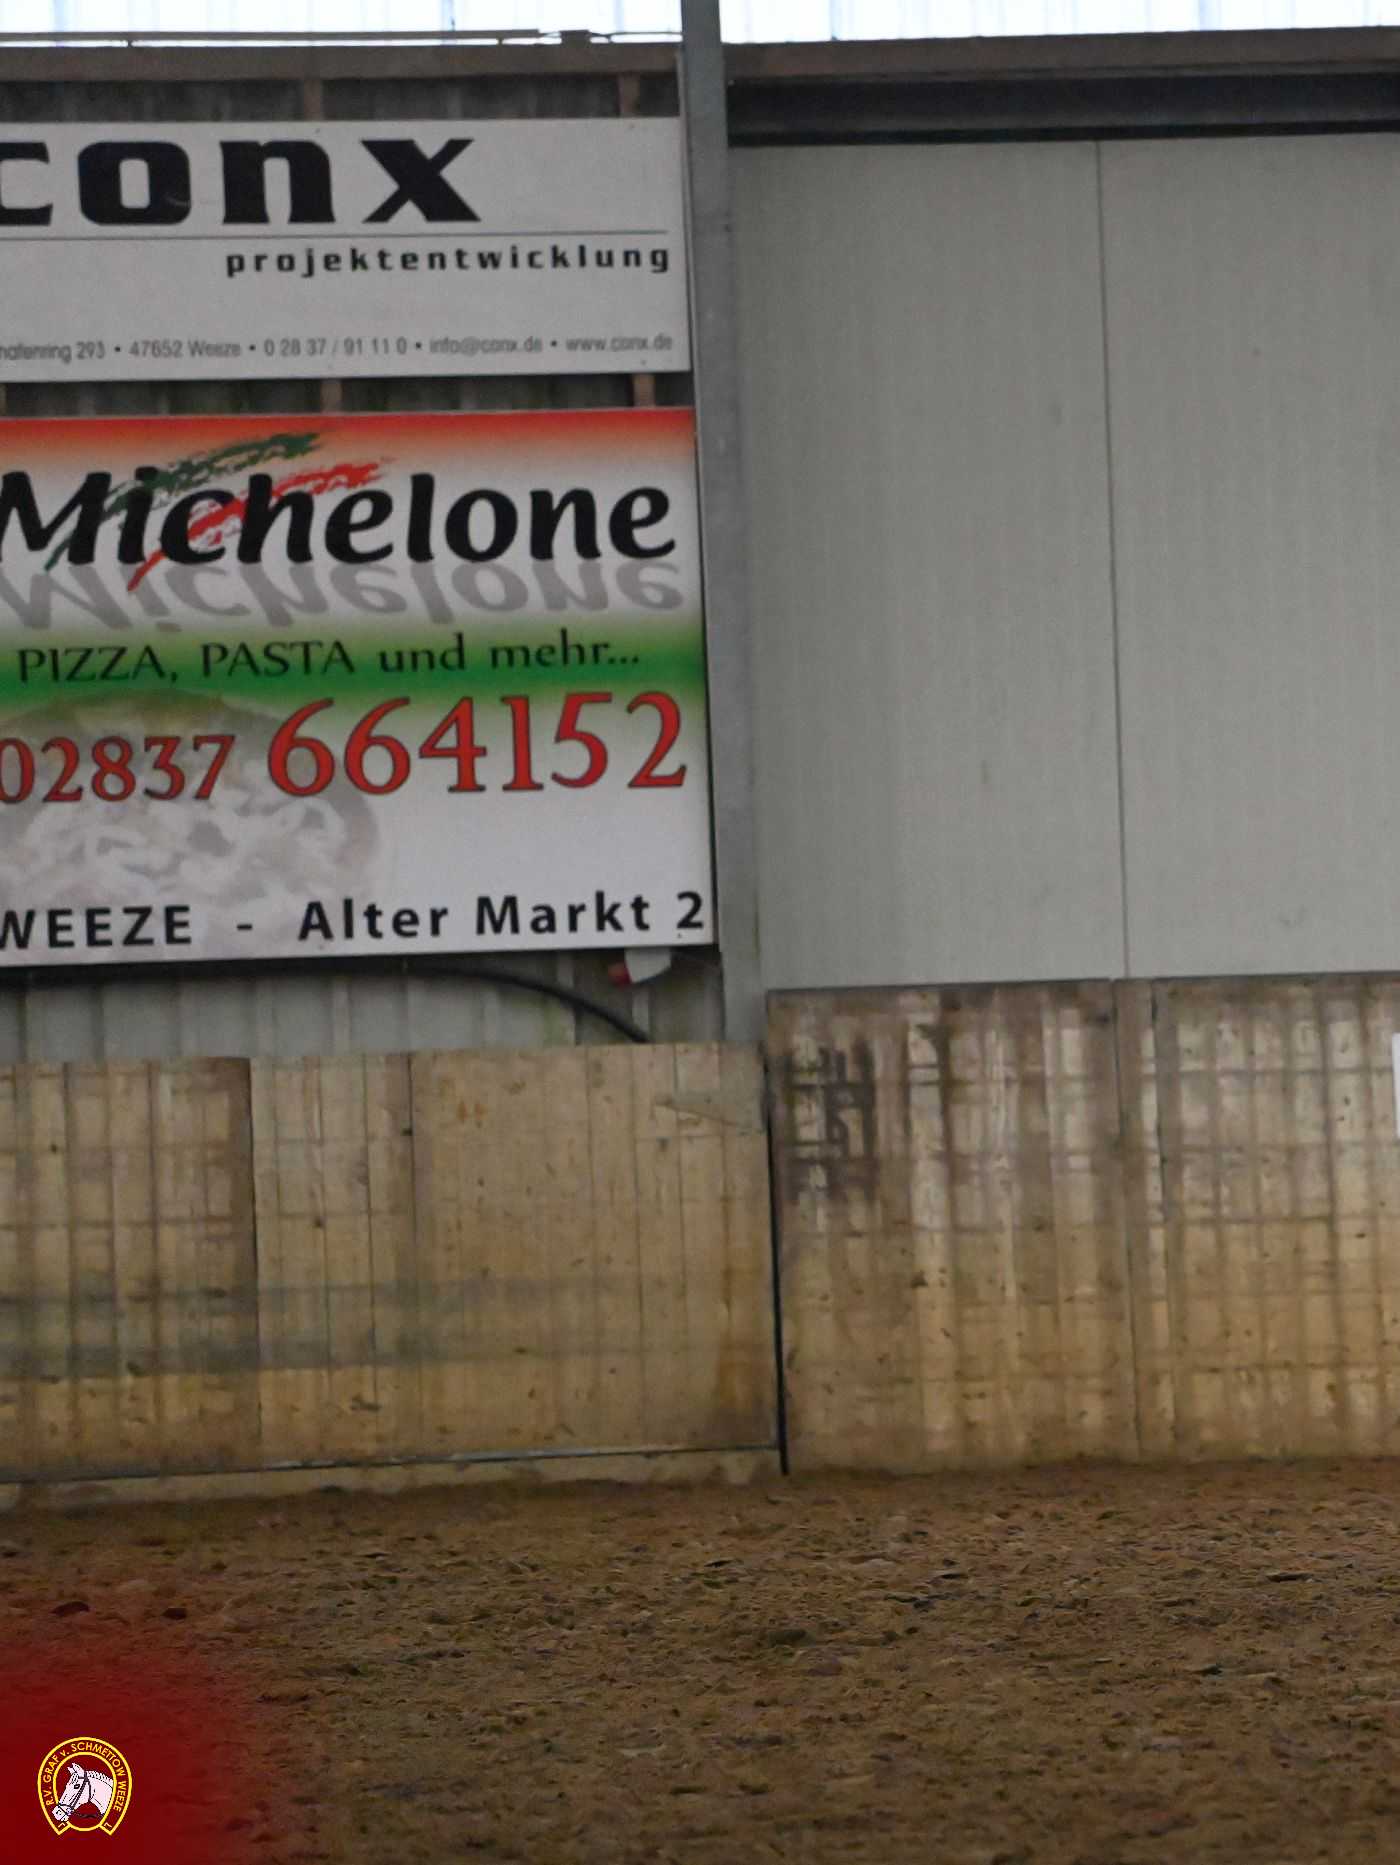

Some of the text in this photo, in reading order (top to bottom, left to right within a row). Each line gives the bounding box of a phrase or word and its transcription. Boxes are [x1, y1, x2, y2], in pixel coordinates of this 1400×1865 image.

[226, 245, 669, 277] projektentwicklung
[0, 466, 676, 565] Michelone
[18, 629, 640, 685] PIZZA, PASTA und mehr...
[0, 692, 687, 804] 02837 664152
[0, 904, 191, 950] WEEZE
[298, 897, 449, 942] Alter
[475, 890, 652, 936] Markt
[676, 892, 705, 931] 2
